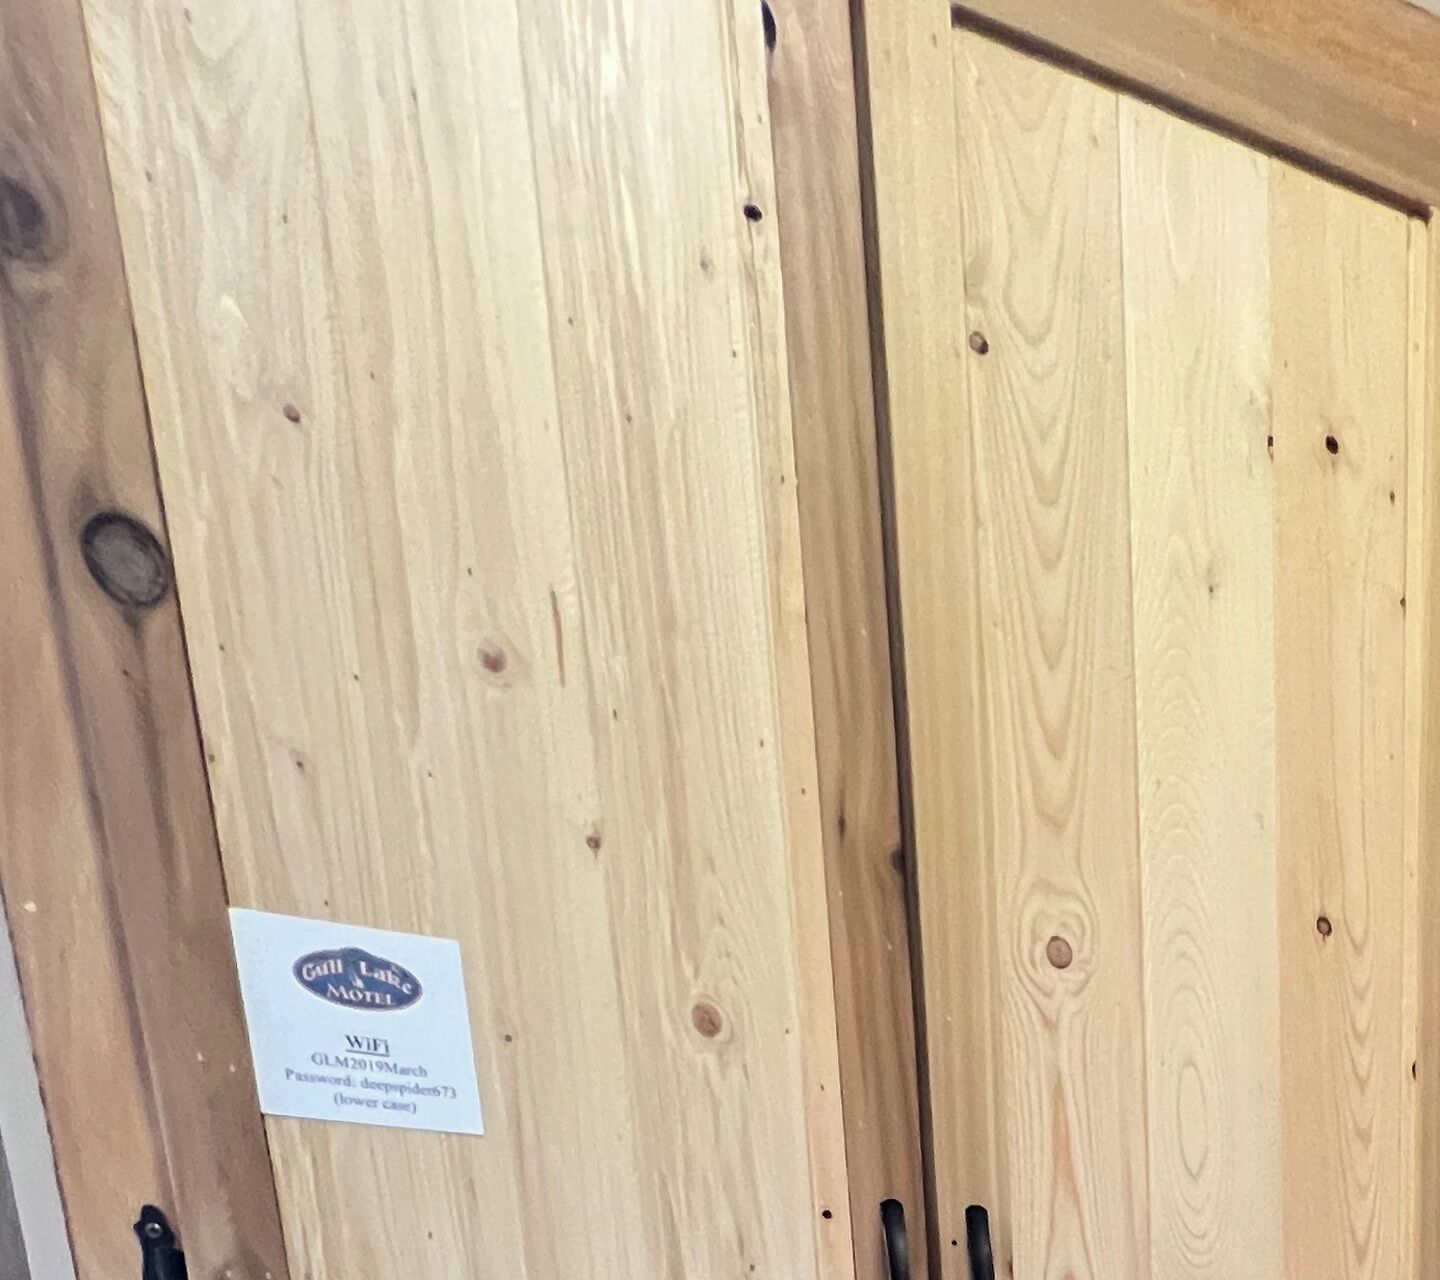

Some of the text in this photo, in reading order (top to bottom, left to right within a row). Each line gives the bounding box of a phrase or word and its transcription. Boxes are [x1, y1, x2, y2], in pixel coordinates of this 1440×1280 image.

[302, 958, 412, 995] Gull Lake
[326, 982, 396, 1006] MOTEL
[345, 1034, 390, 1056] WiFi
[311, 1052, 428, 1079] GLM2019March
[285, 1067, 356, 1088] Password:
[333, 1092, 417, 1114] (lower case)
